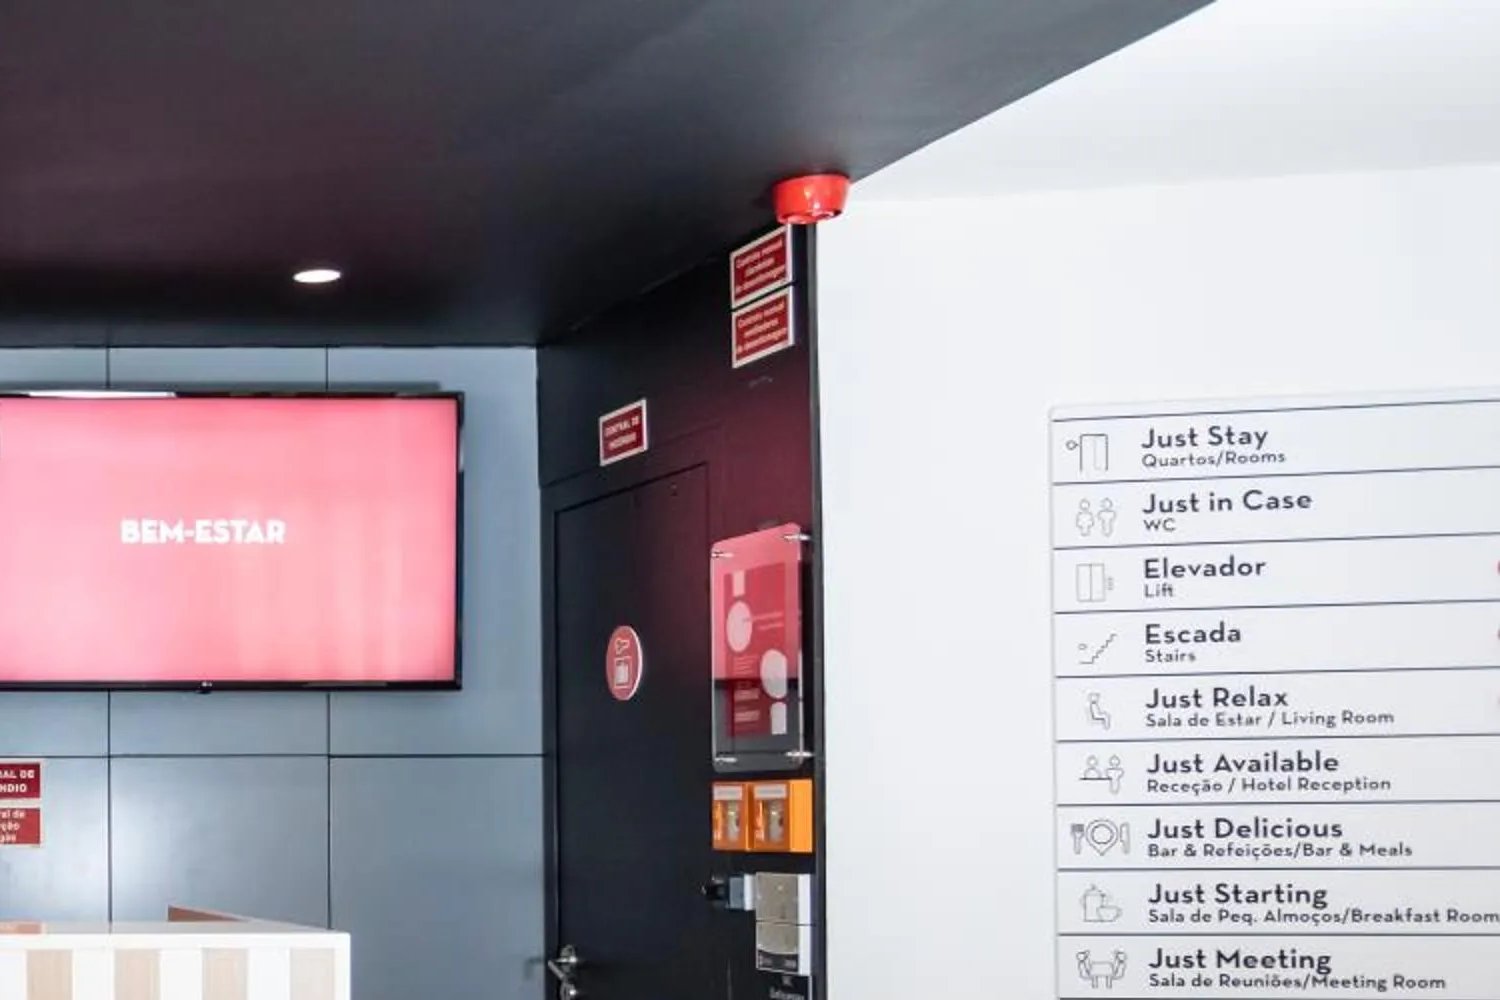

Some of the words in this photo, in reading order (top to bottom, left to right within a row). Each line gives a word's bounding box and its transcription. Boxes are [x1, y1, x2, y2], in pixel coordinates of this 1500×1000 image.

[1141, 427, 1200, 449] Just
[1208, 425, 1269, 449] Stay
[1142, 450, 1286, 468] Quartos/Rooms
[1142, 491, 1200, 514] Just
[1209, 490, 1233, 511] in
[1243, 489, 1313, 510] Case
[120, 518, 286, 544] BEM-ESTAR
[1144, 517, 1176, 532] WC
[1144, 555, 1266, 579] Elevador
[1144, 583, 1174, 598] Lift
[1145, 621, 1242, 644] Escada
[1145, 648, 1196, 662] Stairs
[1145, 687, 1202, 709] Just
[1213, 685, 1289, 707] Relax
[1146, 712, 1182, 727] Sala
[1187, 711, 1209, 726] de
[1216, 711, 1262, 726] Estar
[1267, 711, 1275, 728] /
[1282, 710, 1336, 728] Living
[1342, 710, 1394, 724] Room
[1147, 753, 1203, 773] Just
[1214, 750, 1339, 773] Available
[19, 769, 35, 779] DE
[1147, 778, 1223, 795] Receção
[1228, 777, 1235, 793] /
[1242, 777, 1291, 792] Hotel
[1297, 777, 1391, 794] Reception
[12, 809, 25, 819] de
[1148, 818, 1204, 839] Just
[1215, 816, 1343, 838] Delicious
[1148, 843, 1177, 858] Bar
[1184, 843, 1197, 857] &
[1203, 842, 1334, 861] Refeições/Bar
[1340, 842, 1353, 856] &
[1359, 842, 1413, 857] Meals
[1148, 883, 1205, 904] Just
[1215, 883, 1328, 909] Starting
[1149, 908, 1185, 923] Sala
[1190, 908, 1212, 923] de
[1218, 909, 1258, 927] Peq.
[1264, 907, 1441, 928] Almoços/Breakfast
[1446, 909, 1500, 923] Room
[1149, 948, 1206, 969] Just
[1217, 948, 1332, 975] Meeting
[1150, 973, 1186, 988] Sala
[1192, 973, 1213, 988] de
[1219, 972, 1387, 992] Reuniões/Meeting
[1394, 974, 1446, 989] Room
